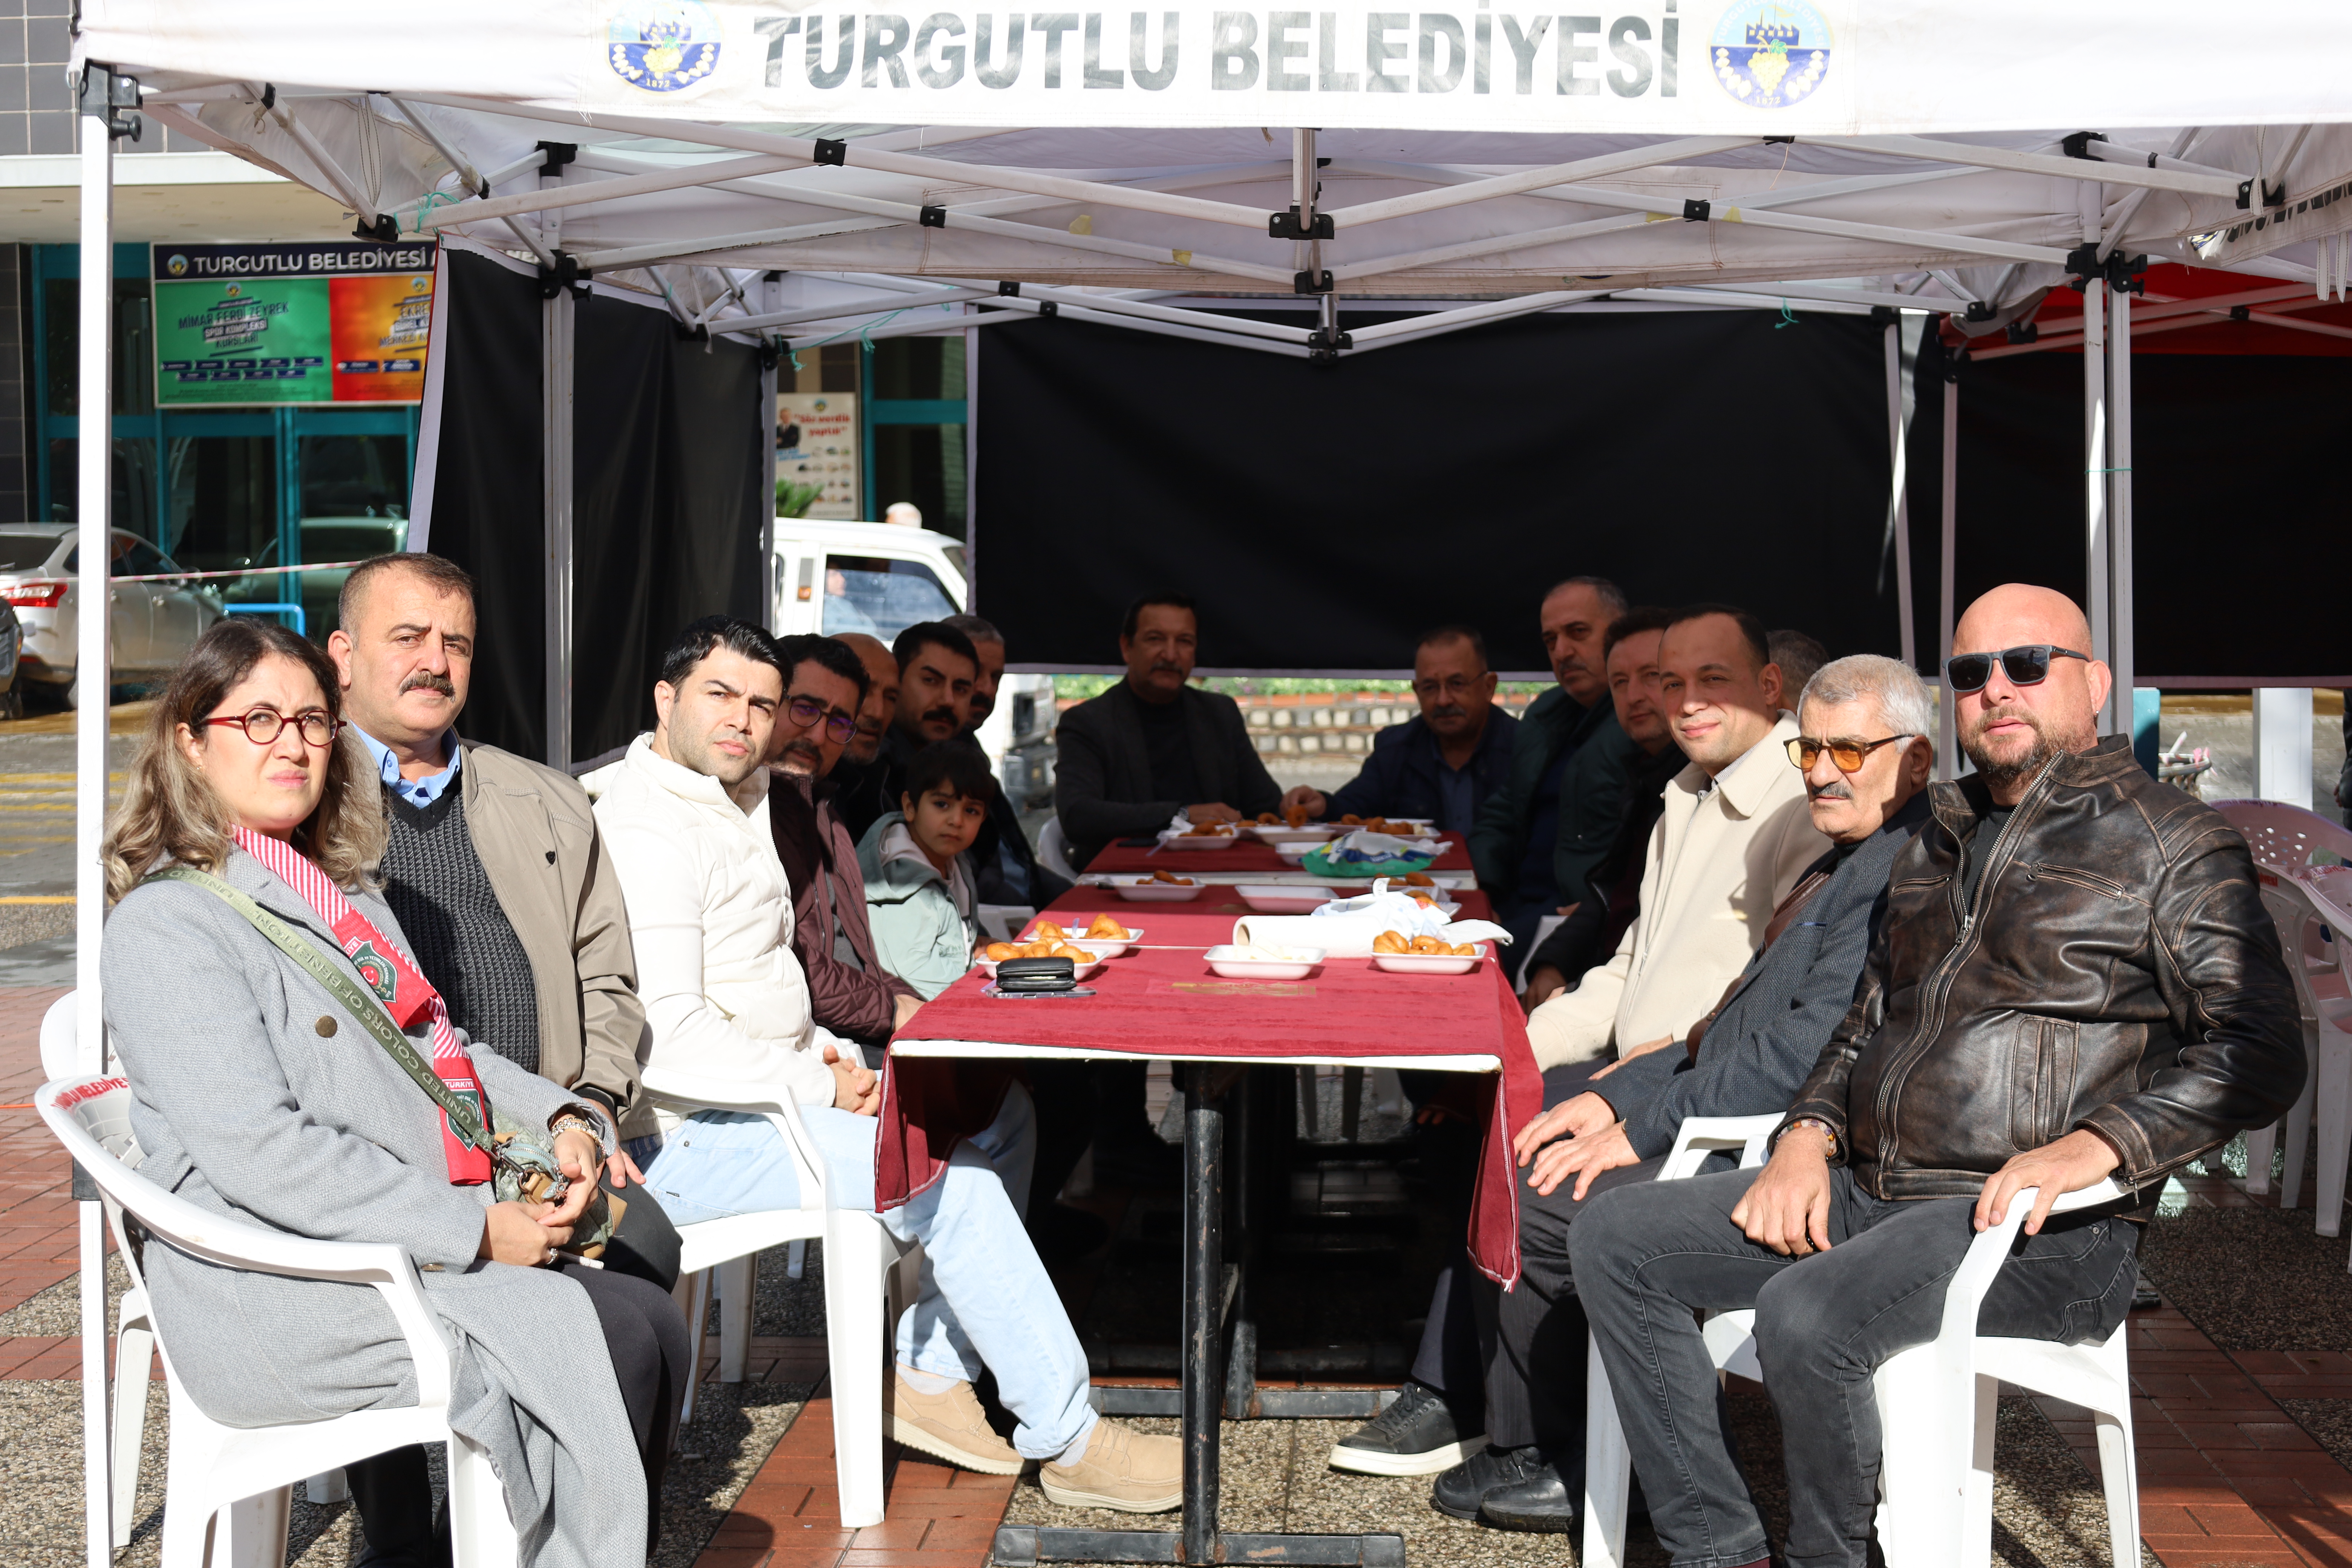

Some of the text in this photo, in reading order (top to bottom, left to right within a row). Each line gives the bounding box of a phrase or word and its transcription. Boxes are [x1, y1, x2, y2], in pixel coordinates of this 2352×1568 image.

[754, 11, 1180, 91] TURGUTLU
[1211, 0, 1679, 98] BELEDİYESİ
[646, 78, 670, 87] 1872
[1756, 96, 1781, 104] 1872
[193, 254, 303, 274] TURGUTLU
[308, 247, 426, 271] BELEDİYESİ
[250, 301, 289, 319] ZEYREK
[341, 985, 363, 1009] OF
[362, 1007, 419, 1069] COLORS
[421, 1071, 472, 1124] UNITED
